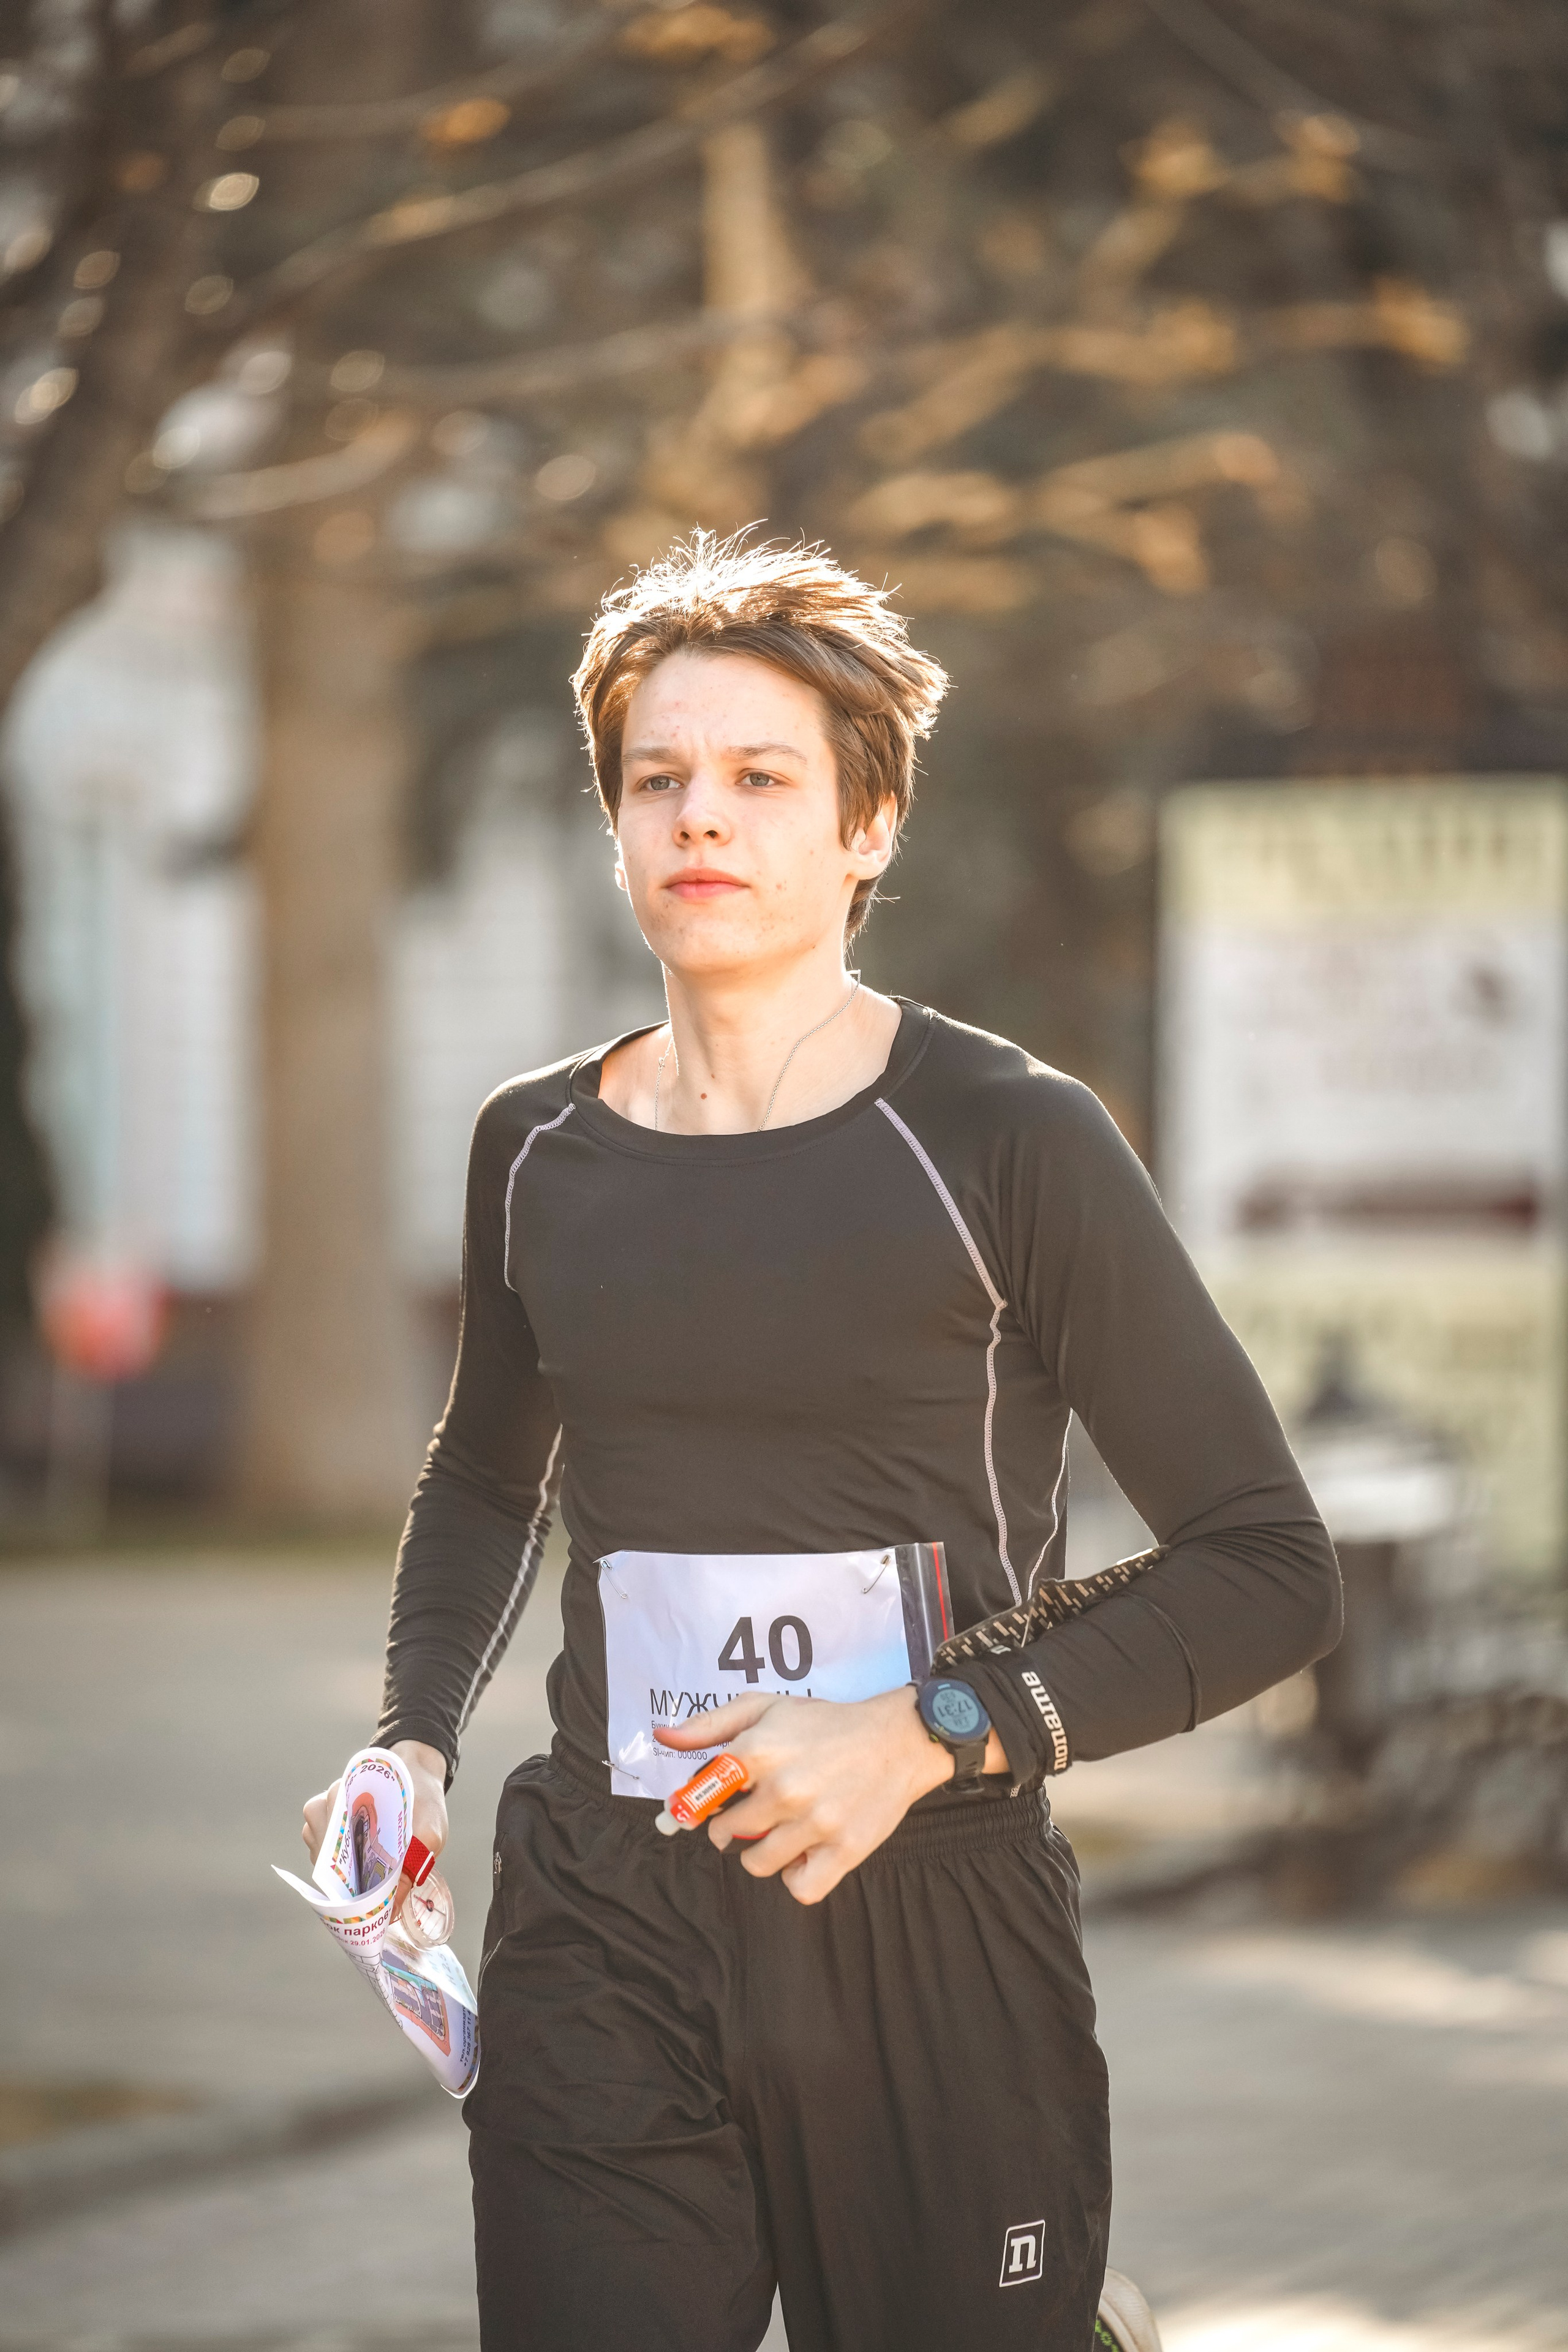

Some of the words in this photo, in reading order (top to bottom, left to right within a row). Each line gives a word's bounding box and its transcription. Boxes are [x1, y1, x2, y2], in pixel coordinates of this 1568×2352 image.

[718, 1615, 813, 1683] 40
[1021, 1671, 1068, 1771] noname
[653, 1747, 676, 1758] SI-чип:
[677, 1749, 707, 1760] 000000
[344, 1908, 391, 1937] парков-
[350, 1928, 386, 1947] 29.01.2026
[467, 2016, 472, 2025] 11
